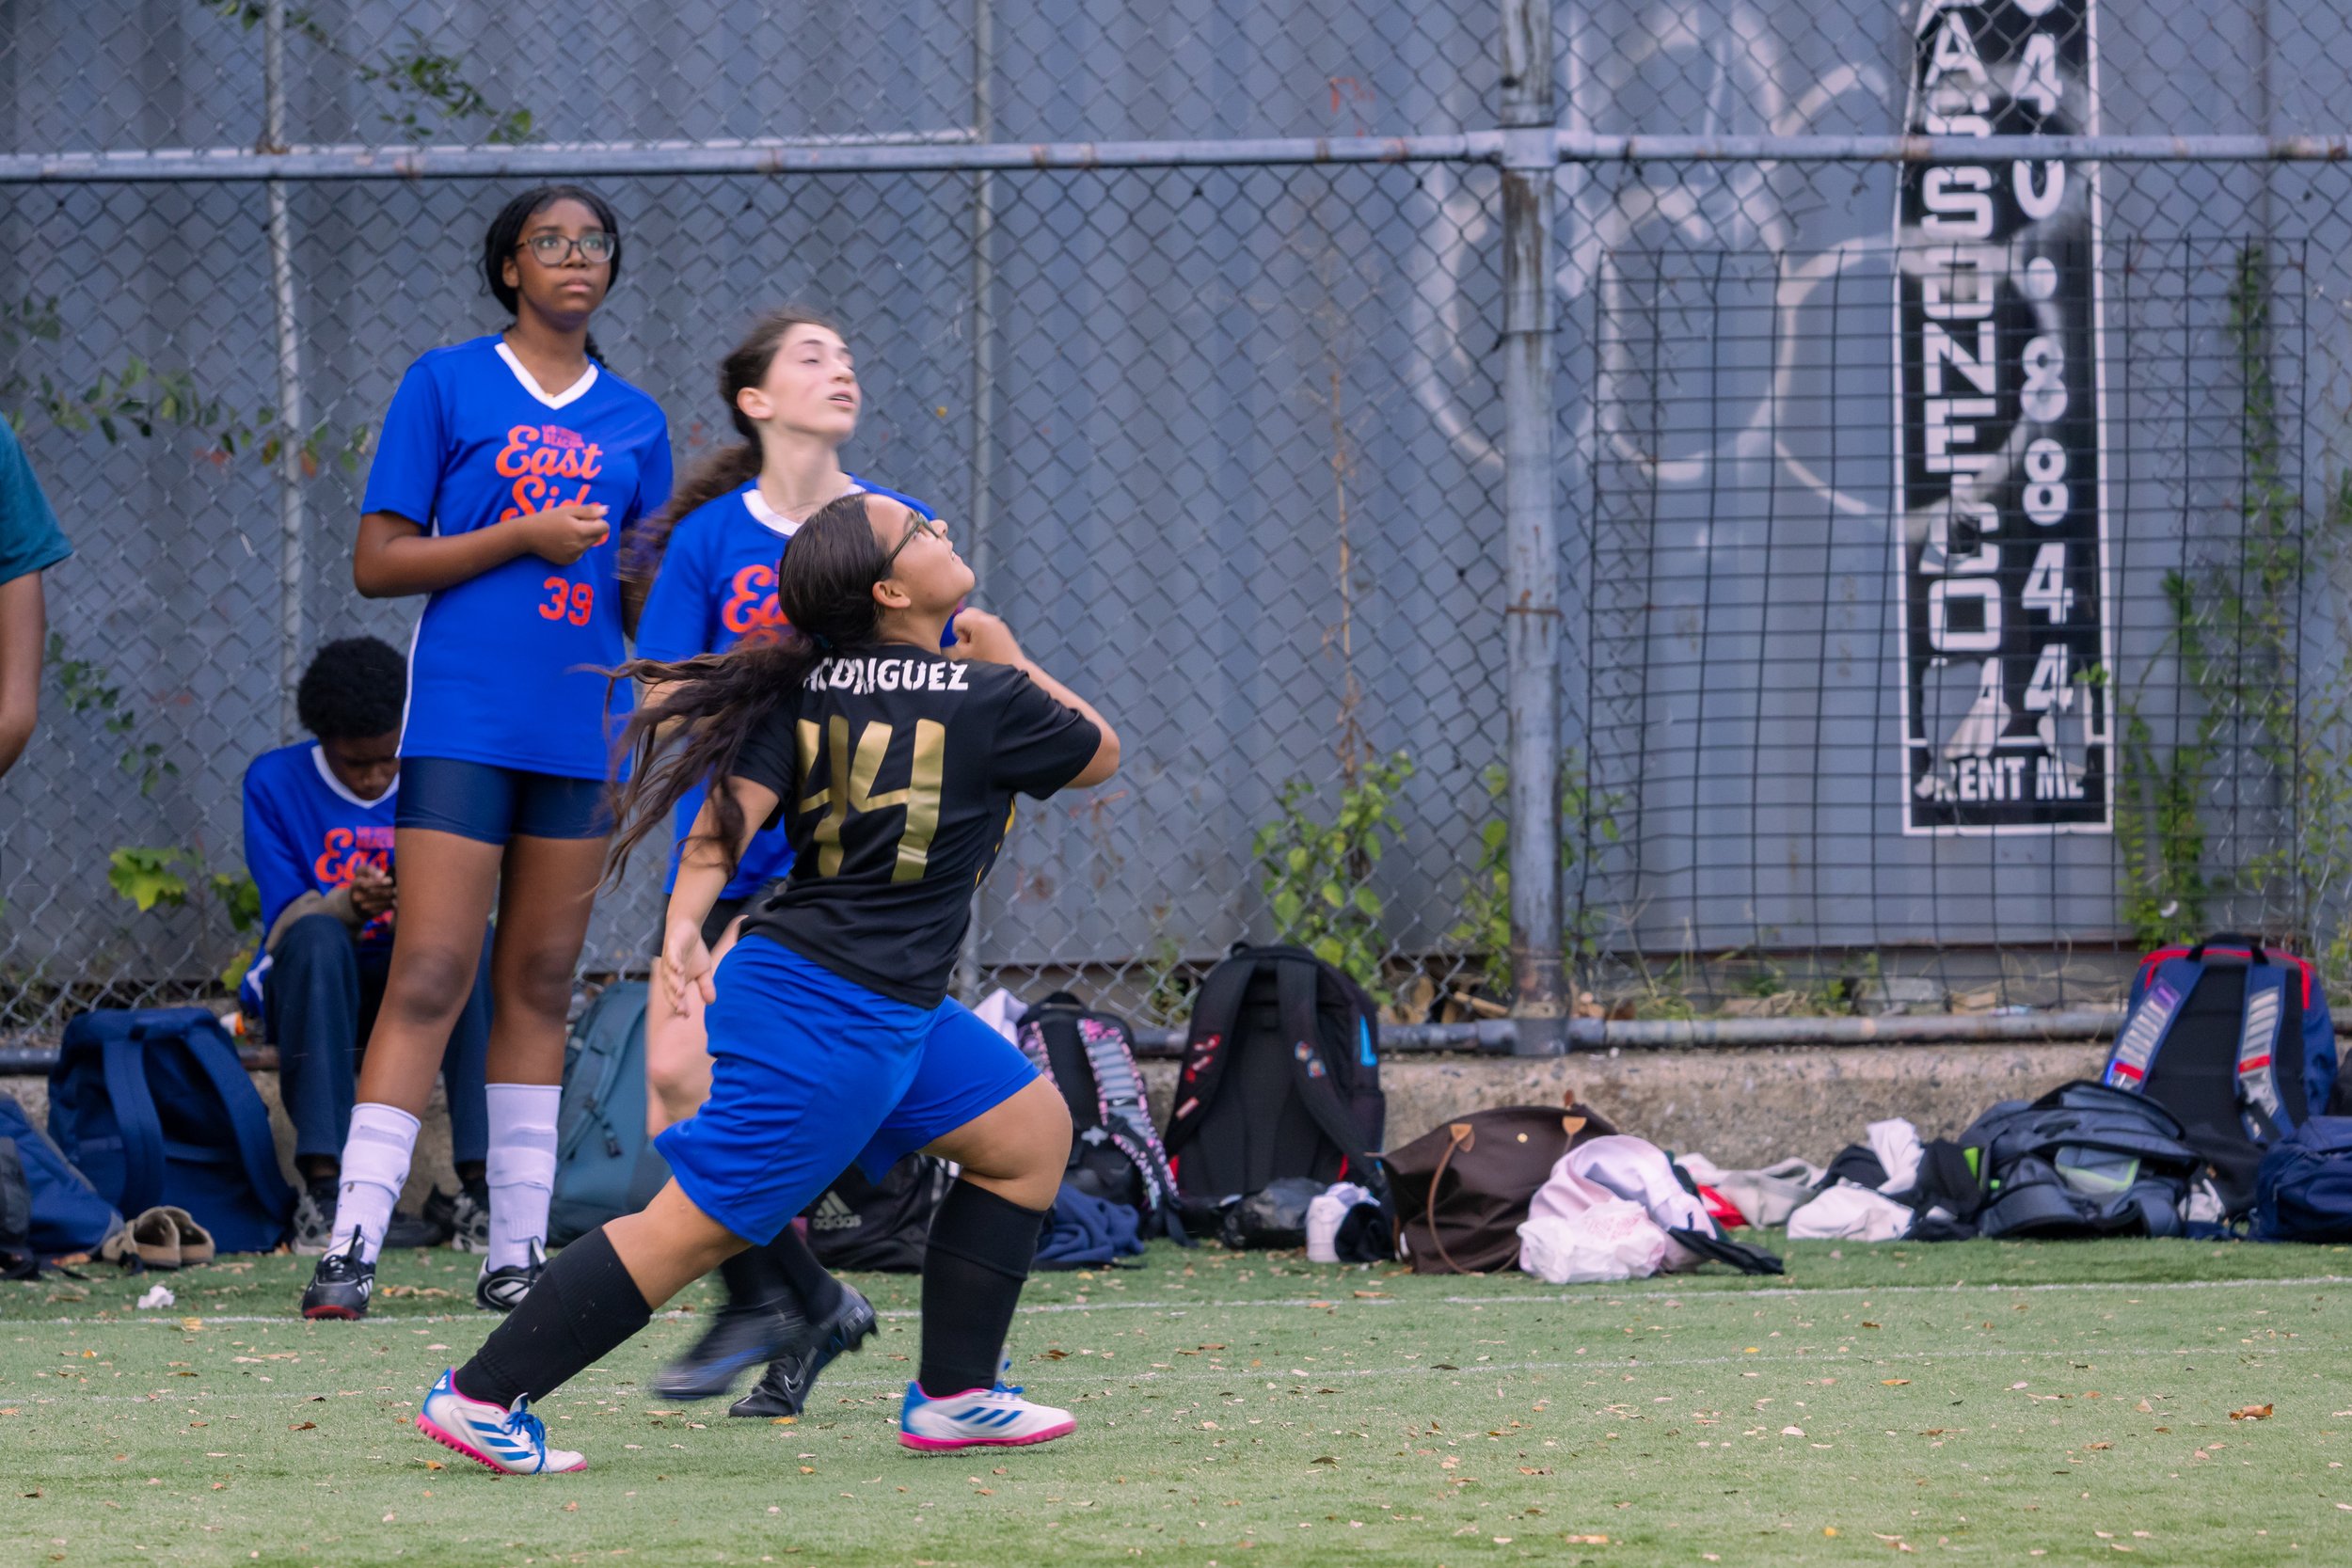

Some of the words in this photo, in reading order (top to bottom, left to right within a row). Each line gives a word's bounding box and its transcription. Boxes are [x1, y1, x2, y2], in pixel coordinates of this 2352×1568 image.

[1923, 0, 2004, 738] ASSONE.CO
[2010, 0, 2074, 715] 40.8844
[495, 424, 603, 480] East
[500, 475, 611, 546] Sid
[538, 576, 595, 626] 39
[721, 564, 790, 633] Ea
[796, 714, 946, 882] 44
[314, 828, 389, 882] Eas
